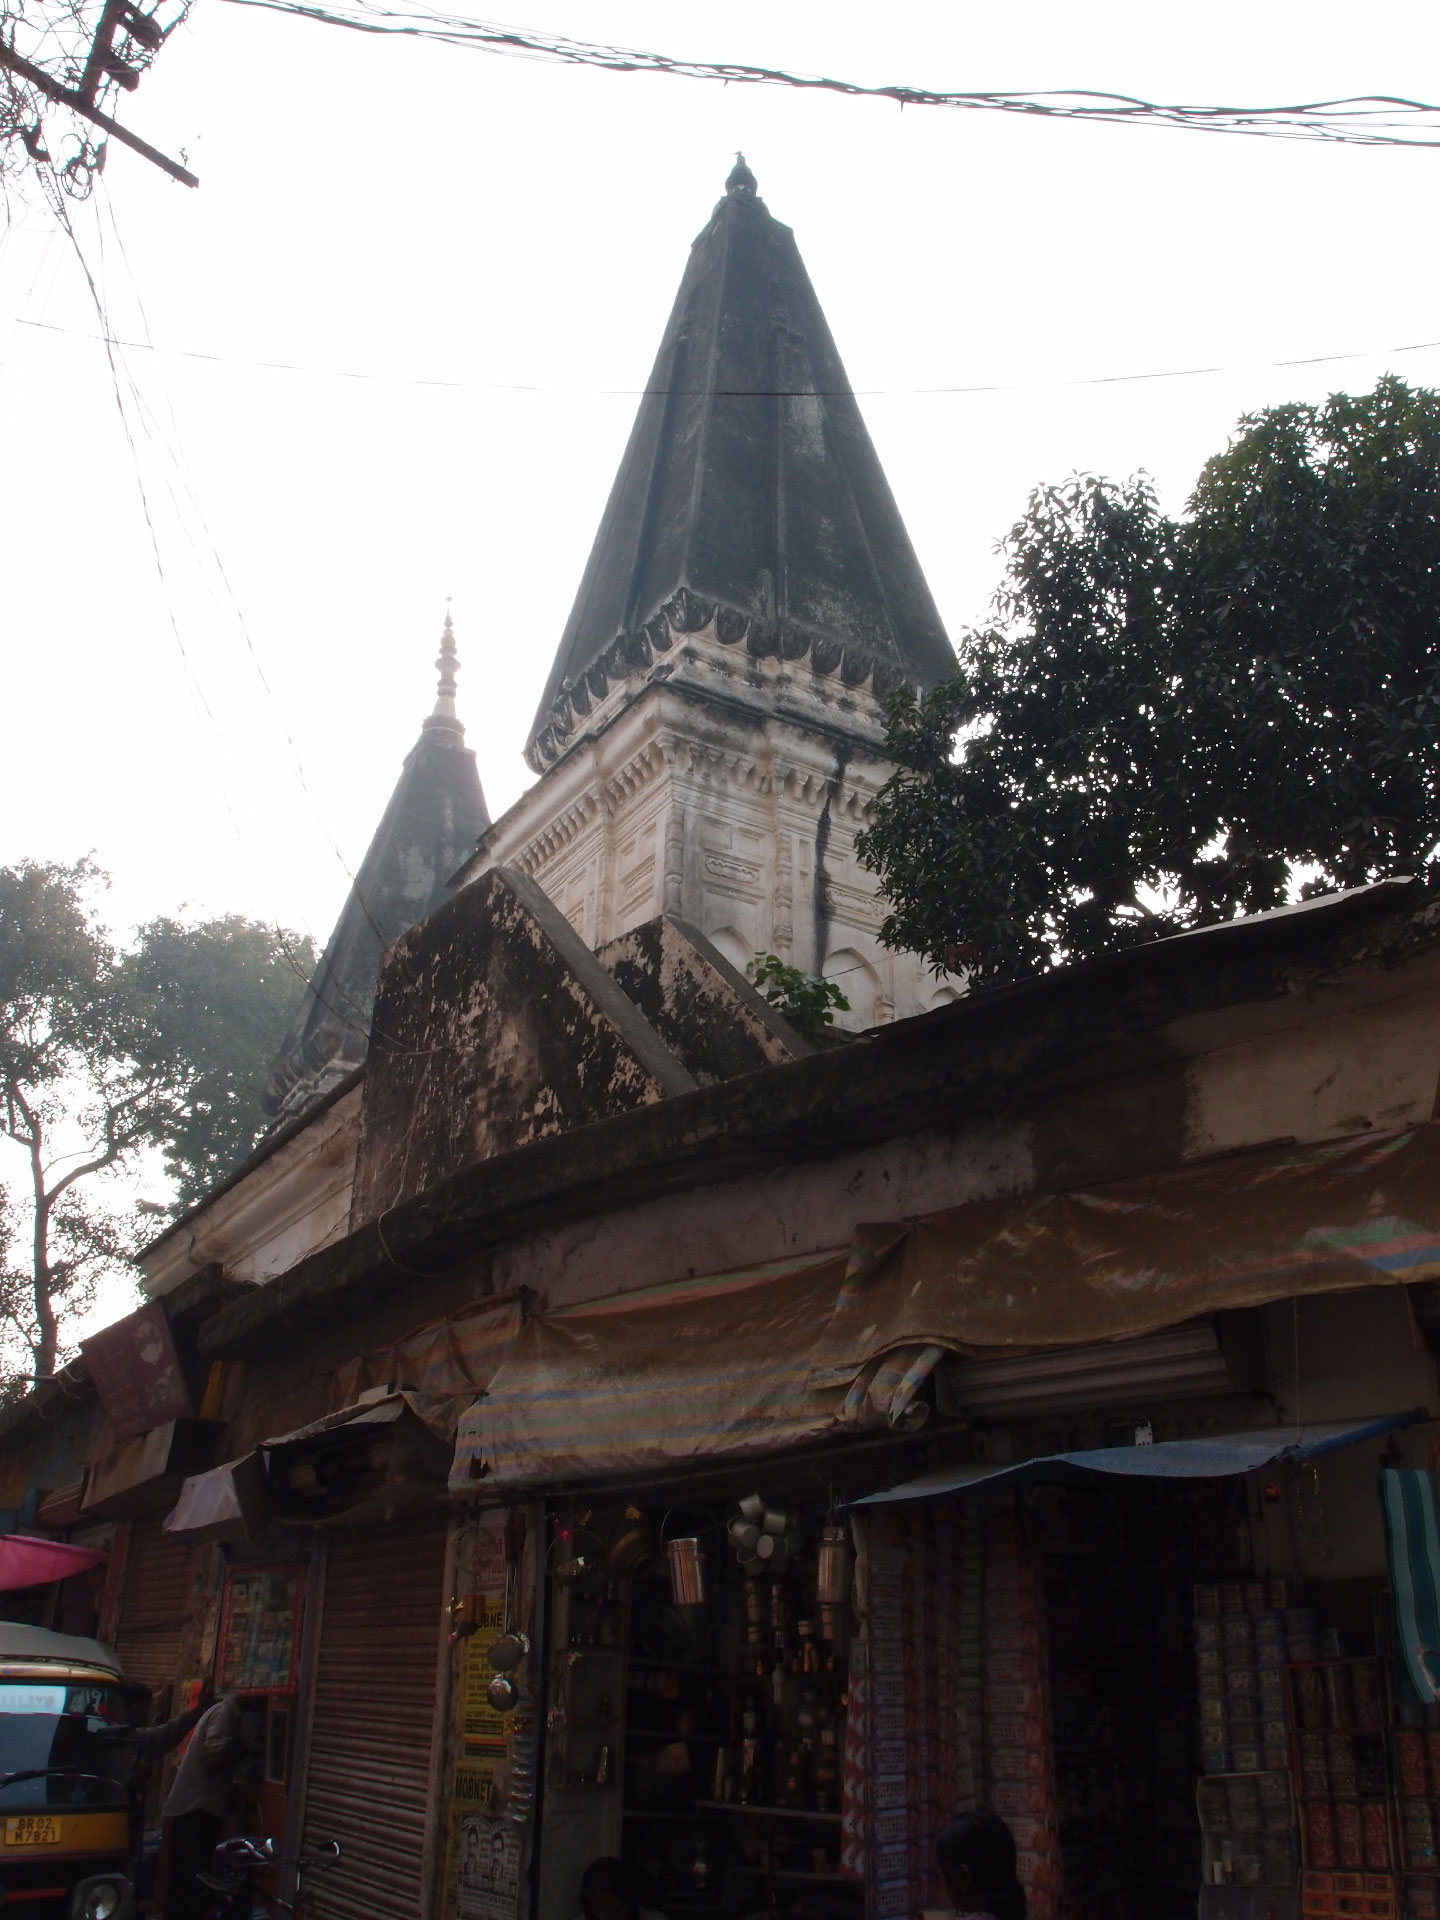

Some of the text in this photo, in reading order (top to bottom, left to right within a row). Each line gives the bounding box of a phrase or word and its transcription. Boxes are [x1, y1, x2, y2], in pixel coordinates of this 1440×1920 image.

[456, 1774, 492, 1801] MOBNET
[18, 1818, 53, 1830] BR 02
